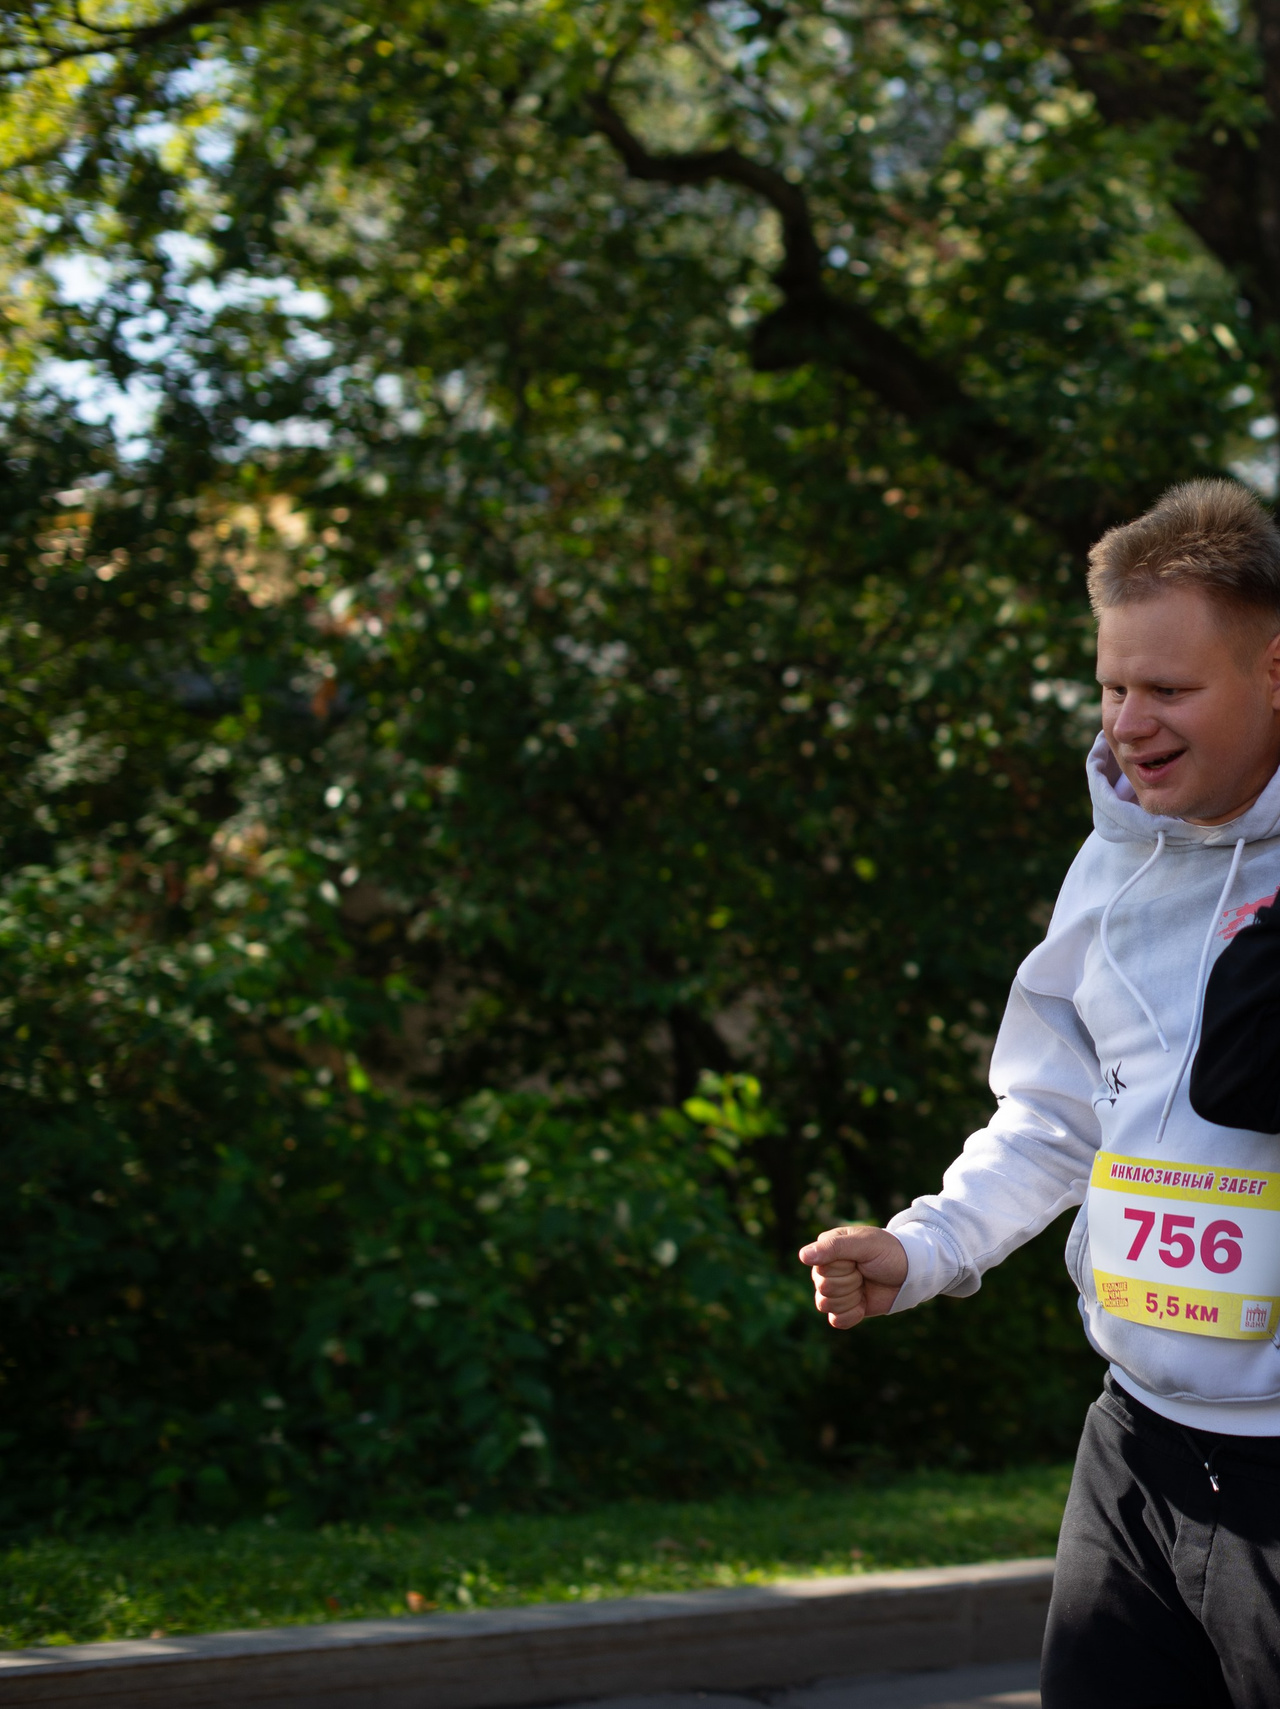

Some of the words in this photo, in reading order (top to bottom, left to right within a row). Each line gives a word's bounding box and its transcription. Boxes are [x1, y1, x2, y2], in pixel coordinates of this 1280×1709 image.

[1110, 1163, 1214, 1191] ИНКЛЮЗИВНЫЙ
[1218, 1177, 1268, 1196] ЗАБЕГ
[1123, 1207, 1244, 1275] 756
[1145, 1291, 1180, 1320] 5,5
